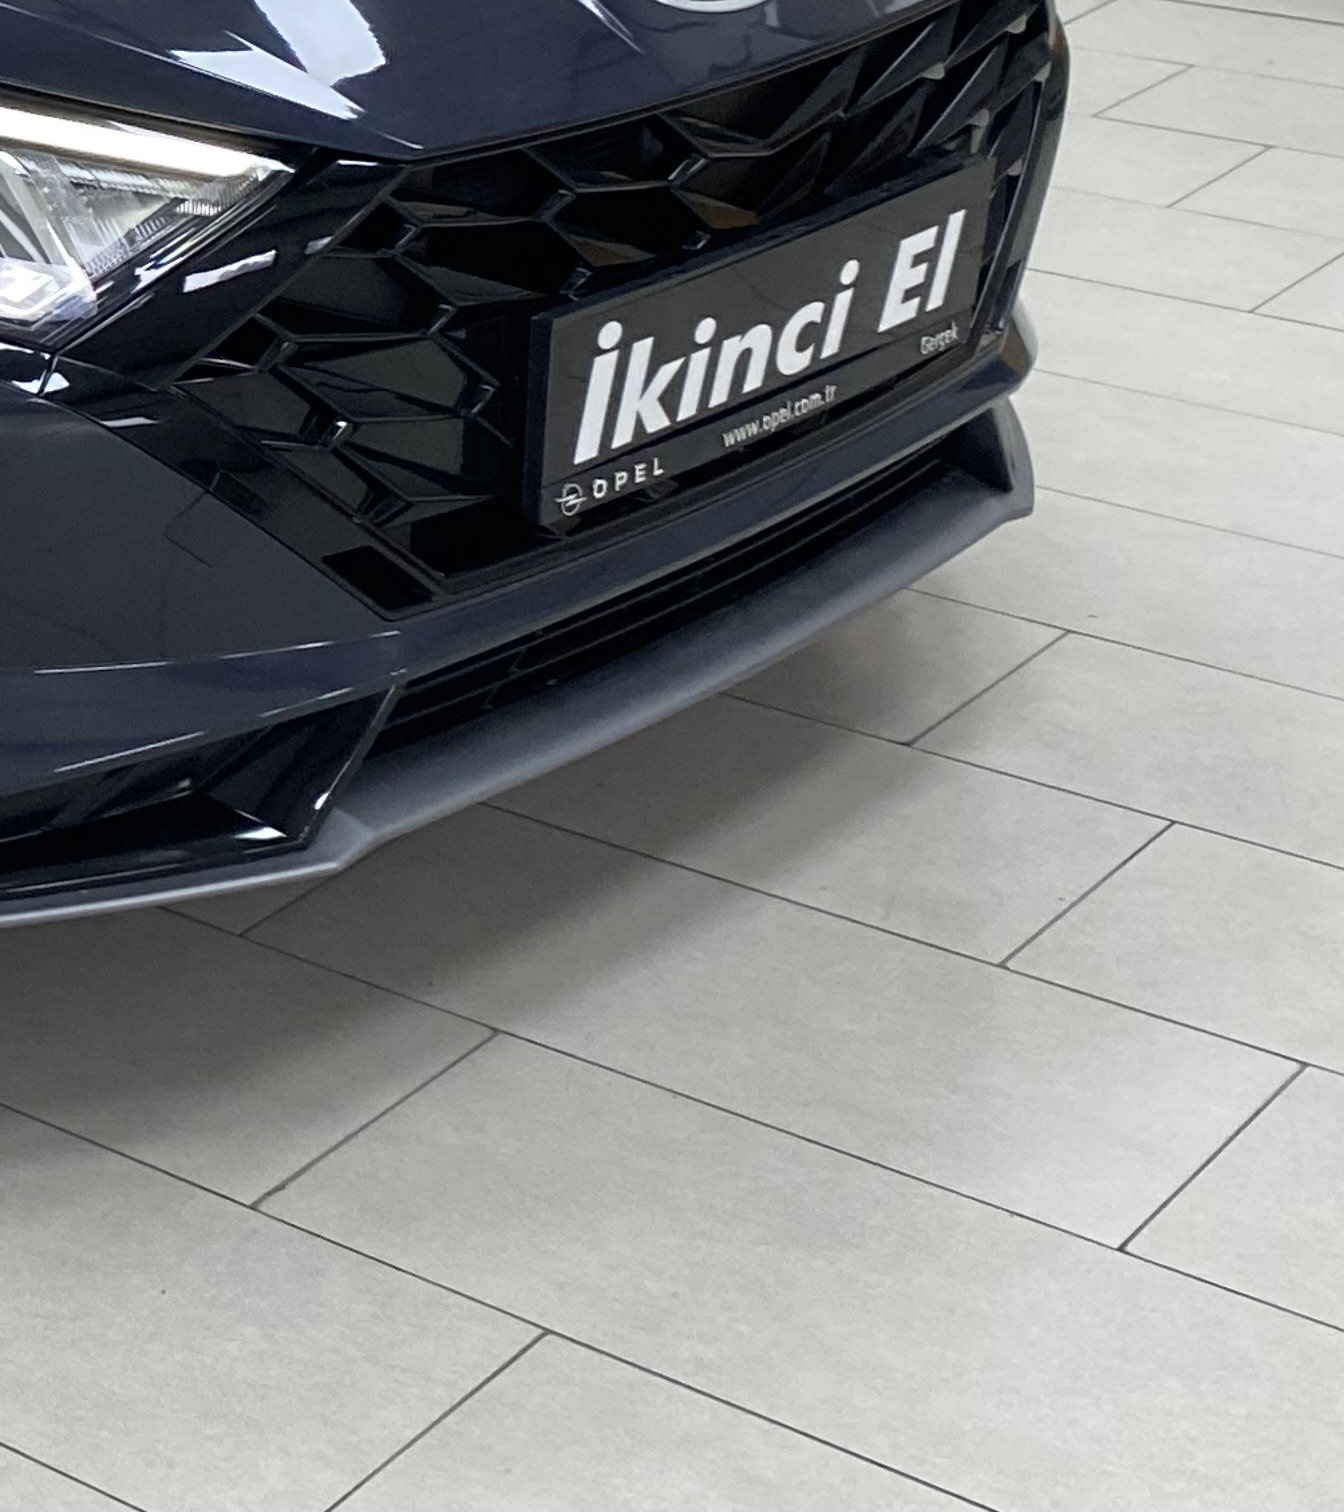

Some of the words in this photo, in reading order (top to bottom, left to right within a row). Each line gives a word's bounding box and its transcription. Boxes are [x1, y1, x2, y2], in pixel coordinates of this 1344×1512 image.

[573, 258, 860, 465] İkinci
[876, 208, 967, 333] El
[722, 384, 837, 448] www.opel.com.tr
[592, 457, 665, 499] OPEL
